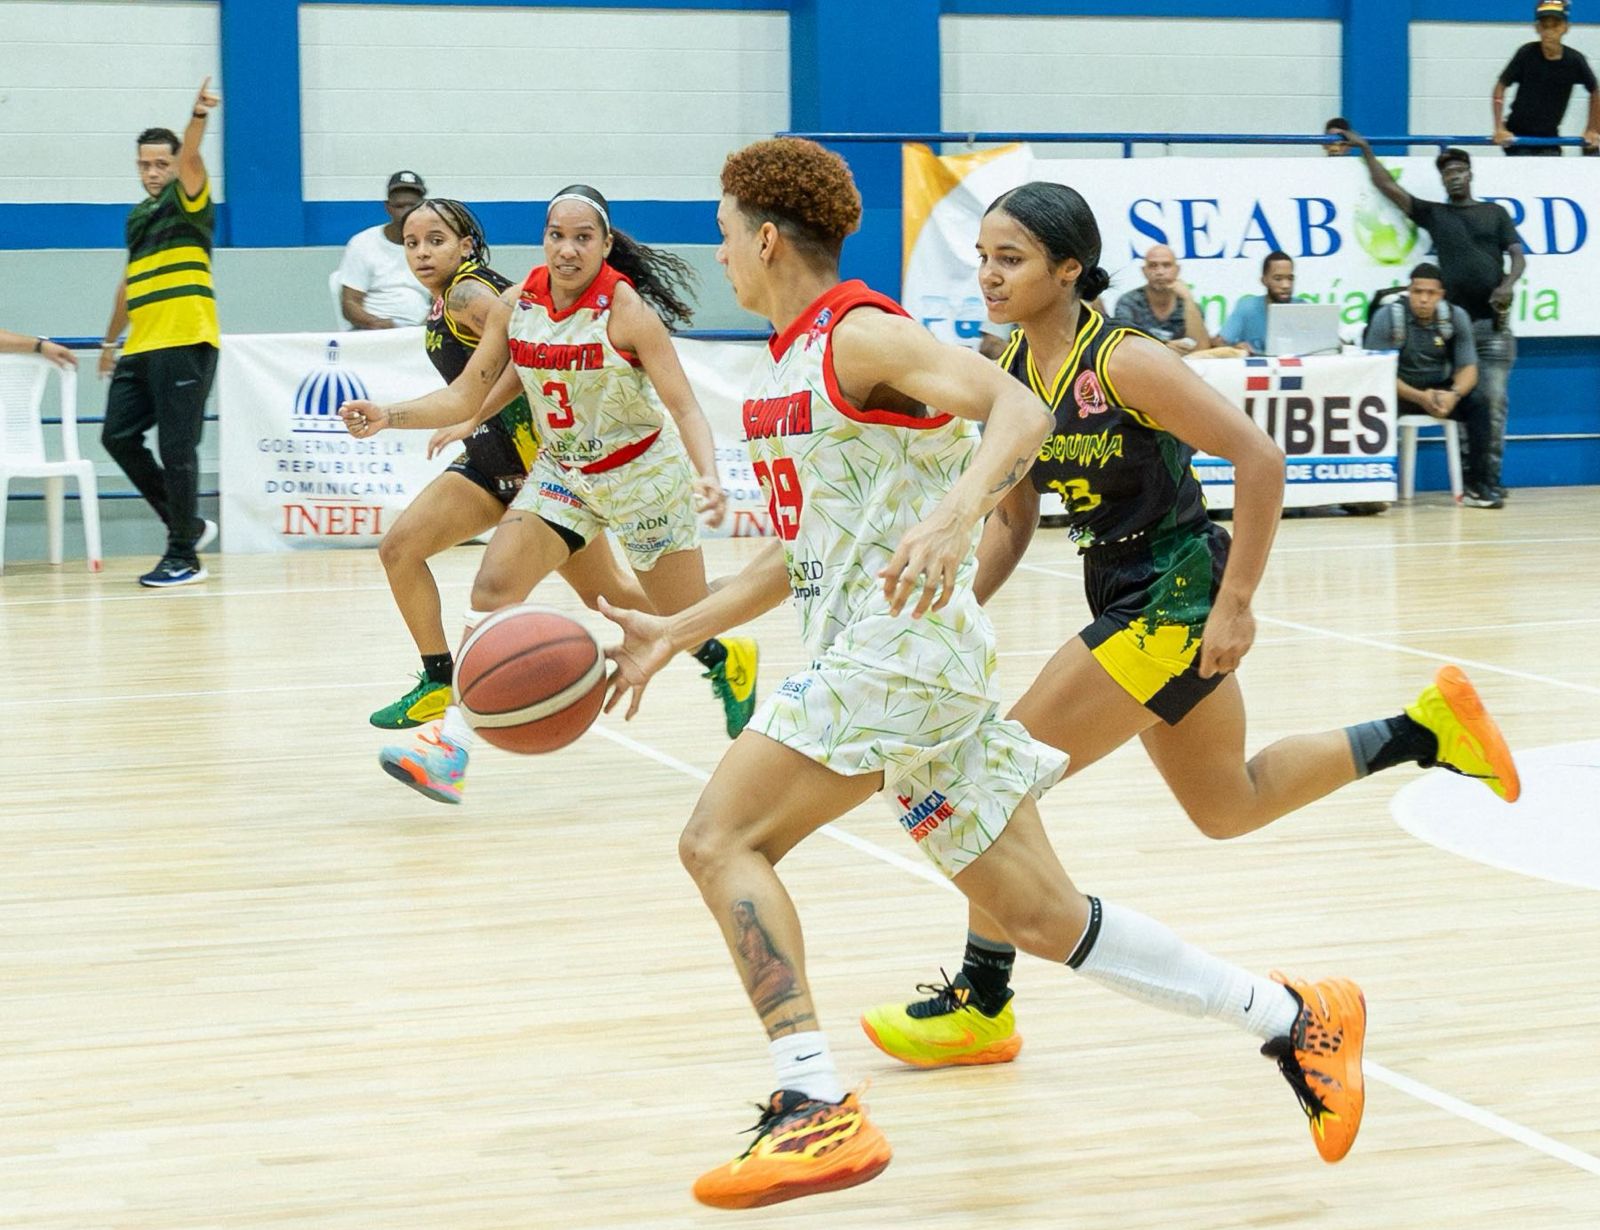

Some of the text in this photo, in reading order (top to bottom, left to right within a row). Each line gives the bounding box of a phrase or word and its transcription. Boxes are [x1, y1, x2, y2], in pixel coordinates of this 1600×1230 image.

[542, 381, 575, 429] 3
[1245, 396, 1388, 454] UBES
[257, 438, 404, 455] GOBIERNO DE LA
[1038, 428, 1123, 469] SQUINA
[277, 459, 393, 474] REPUBLICA
[1286, 463, 1393, 480] DE CLUBES
[265, 480, 406, 495] DOMINICANA
[281, 503, 384, 536] INEFI
[637, 515, 668, 531] ADN
